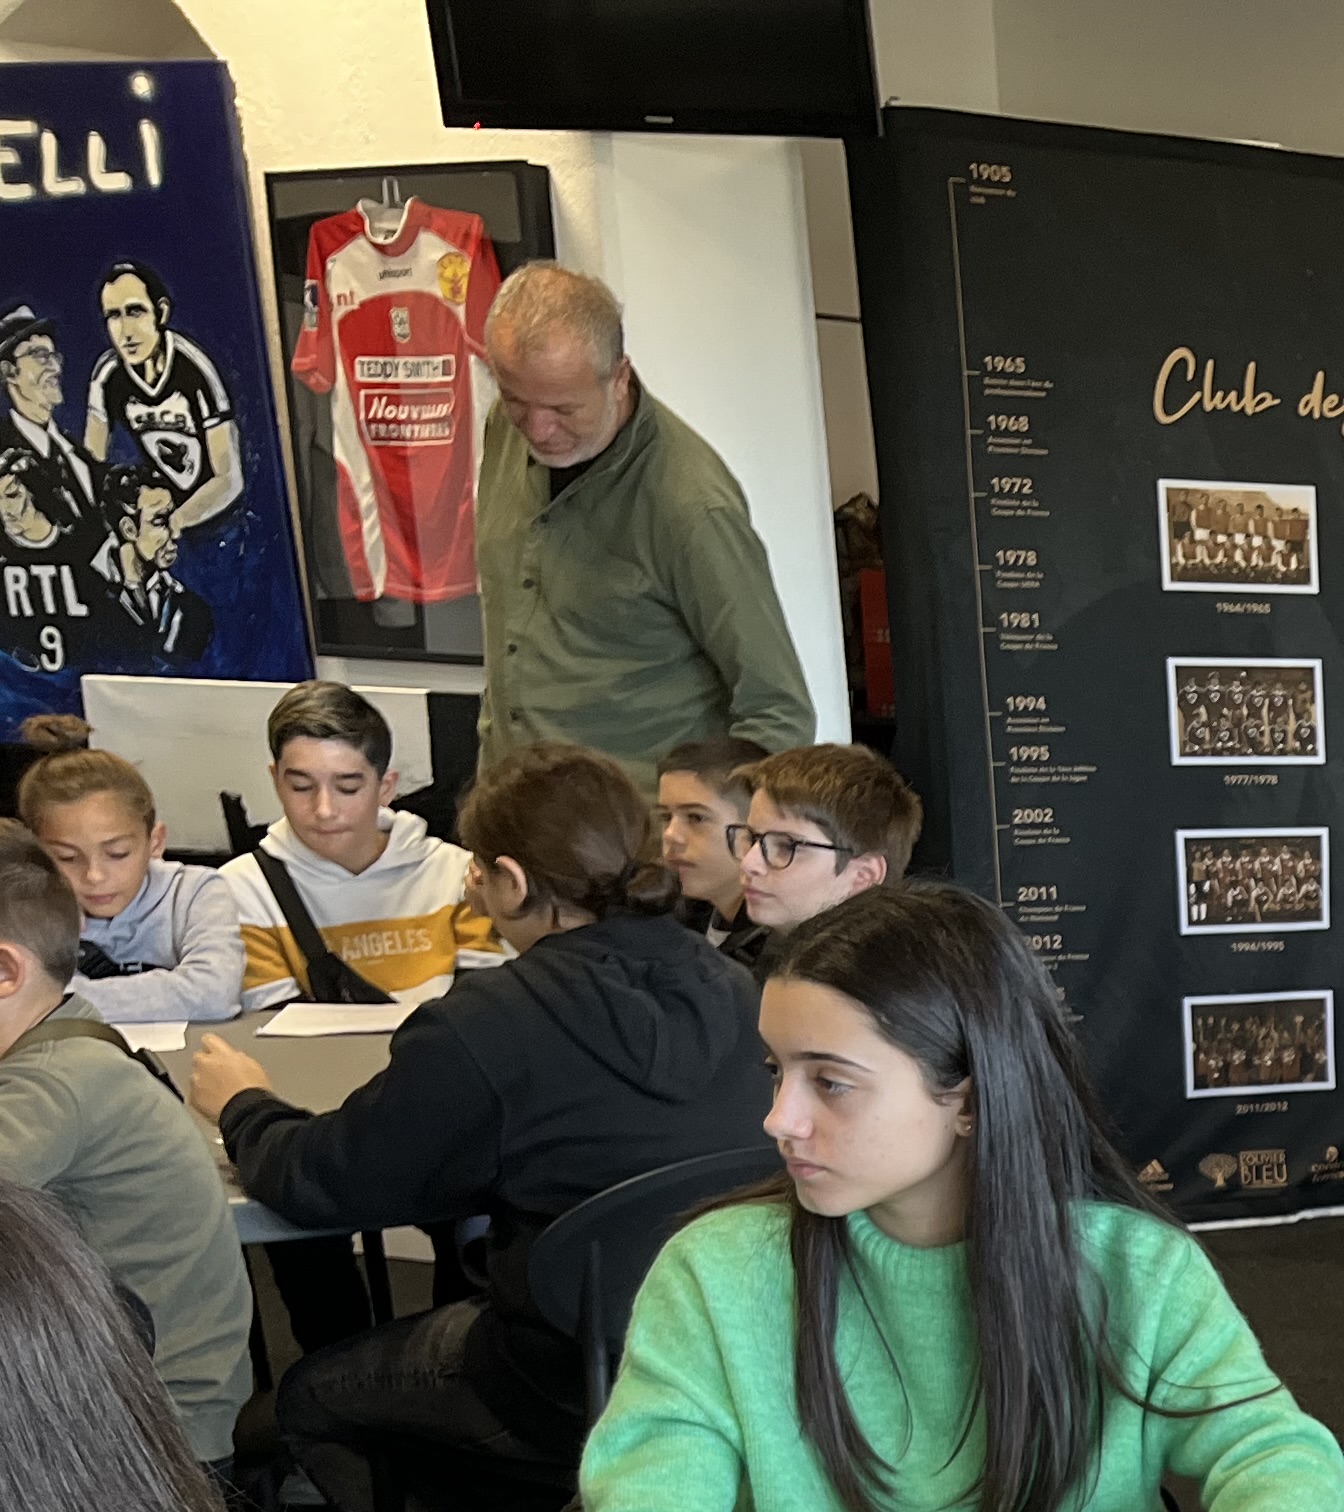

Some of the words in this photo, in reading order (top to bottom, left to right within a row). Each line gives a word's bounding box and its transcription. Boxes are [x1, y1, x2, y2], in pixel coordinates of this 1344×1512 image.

[969, 162, 1013, 183] 1905
[983, 355, 1026, 374] 1965
[1153, 346, 1281, 425] Club
[987, 414, 1030, 432] 1968
[991, 476, 1034, 495] 1972
[995, 550, 1038, 567] 1978
[3, 564, 90, 617] RTL
[999, 611, 1040, 629] 1981
[39, 625, 65, 672] 9
[1006, 695, 1047, 711] 1994
[1009, 745, 1051, 762] 1995
[1013, 807, 1054, 824] 2002
[1017, 885, 1058, 901] 2011
[341, 928, 433, 961] ANGELES
[1241, 1163, 1288, 1184] BLEU
